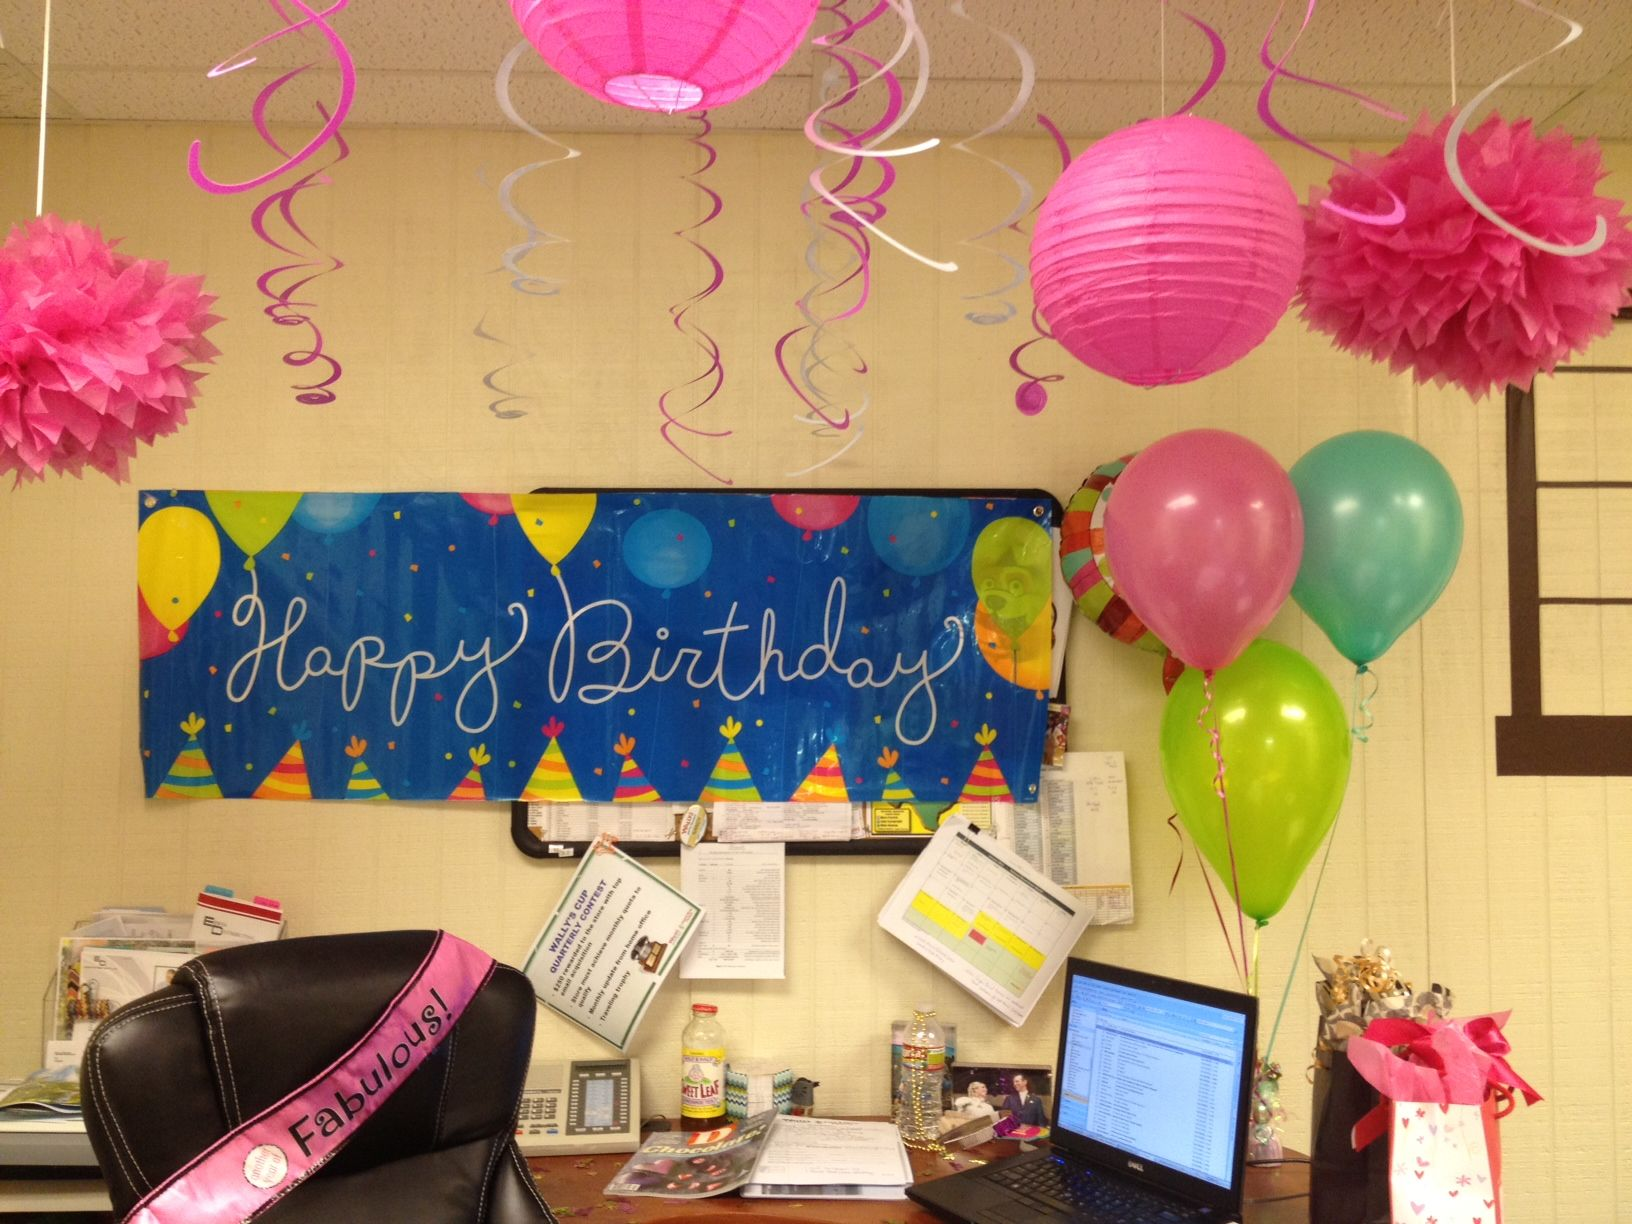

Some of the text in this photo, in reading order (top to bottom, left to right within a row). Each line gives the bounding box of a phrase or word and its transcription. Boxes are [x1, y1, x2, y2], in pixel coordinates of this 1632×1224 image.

[226, 576, 965, 746] Happy Birthday
[549, 889, 590, 953] WALLY'S CUP
[549, 880, 607, 974] QUARTERLY CONTEST
[554, 877, 623, 992] $250 rewarded to the store with top
[571, 886, 641, 1003] Store must achieve monthly quota to
[589, 909, 651, 1015] Monthly update from home office
[561, 942, 593, 996] email acquisition
[578, 986, 592, 1008] qualify
[601, 970, 631, 1021] Traveling trophy
[288, 988, 453, 1157] Fabulous!
[700, 1080, 719, 1098] LEAF
